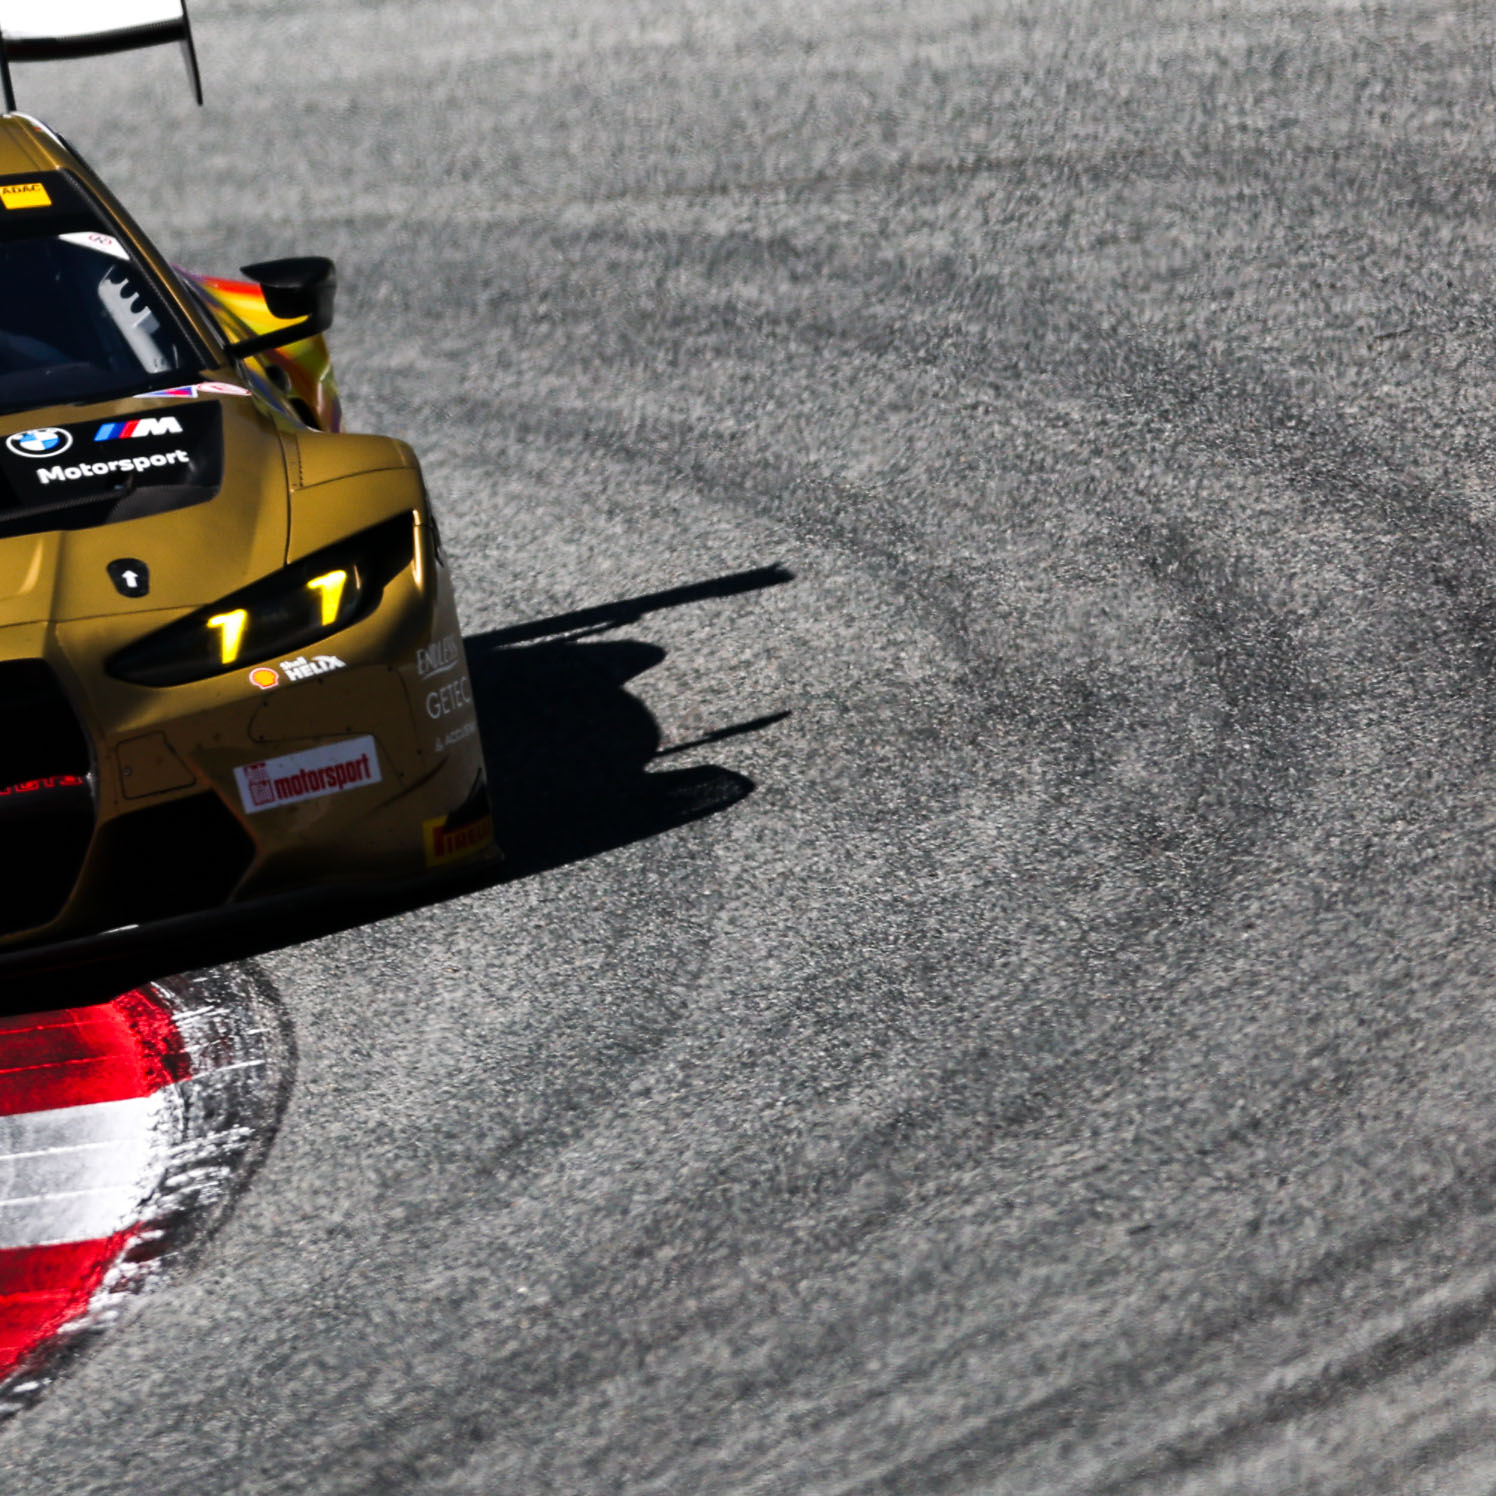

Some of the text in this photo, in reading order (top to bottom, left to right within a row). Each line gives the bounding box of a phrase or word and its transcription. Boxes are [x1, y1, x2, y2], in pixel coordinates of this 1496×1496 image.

[1, 184, 42, 196] ADAC
[36, 449, 190, 485] Motorsport
[284, 655, 347, 682] HELIX
[426, 676, 471, 719] GETEC
[274, 753, 372, 799] motorsport
